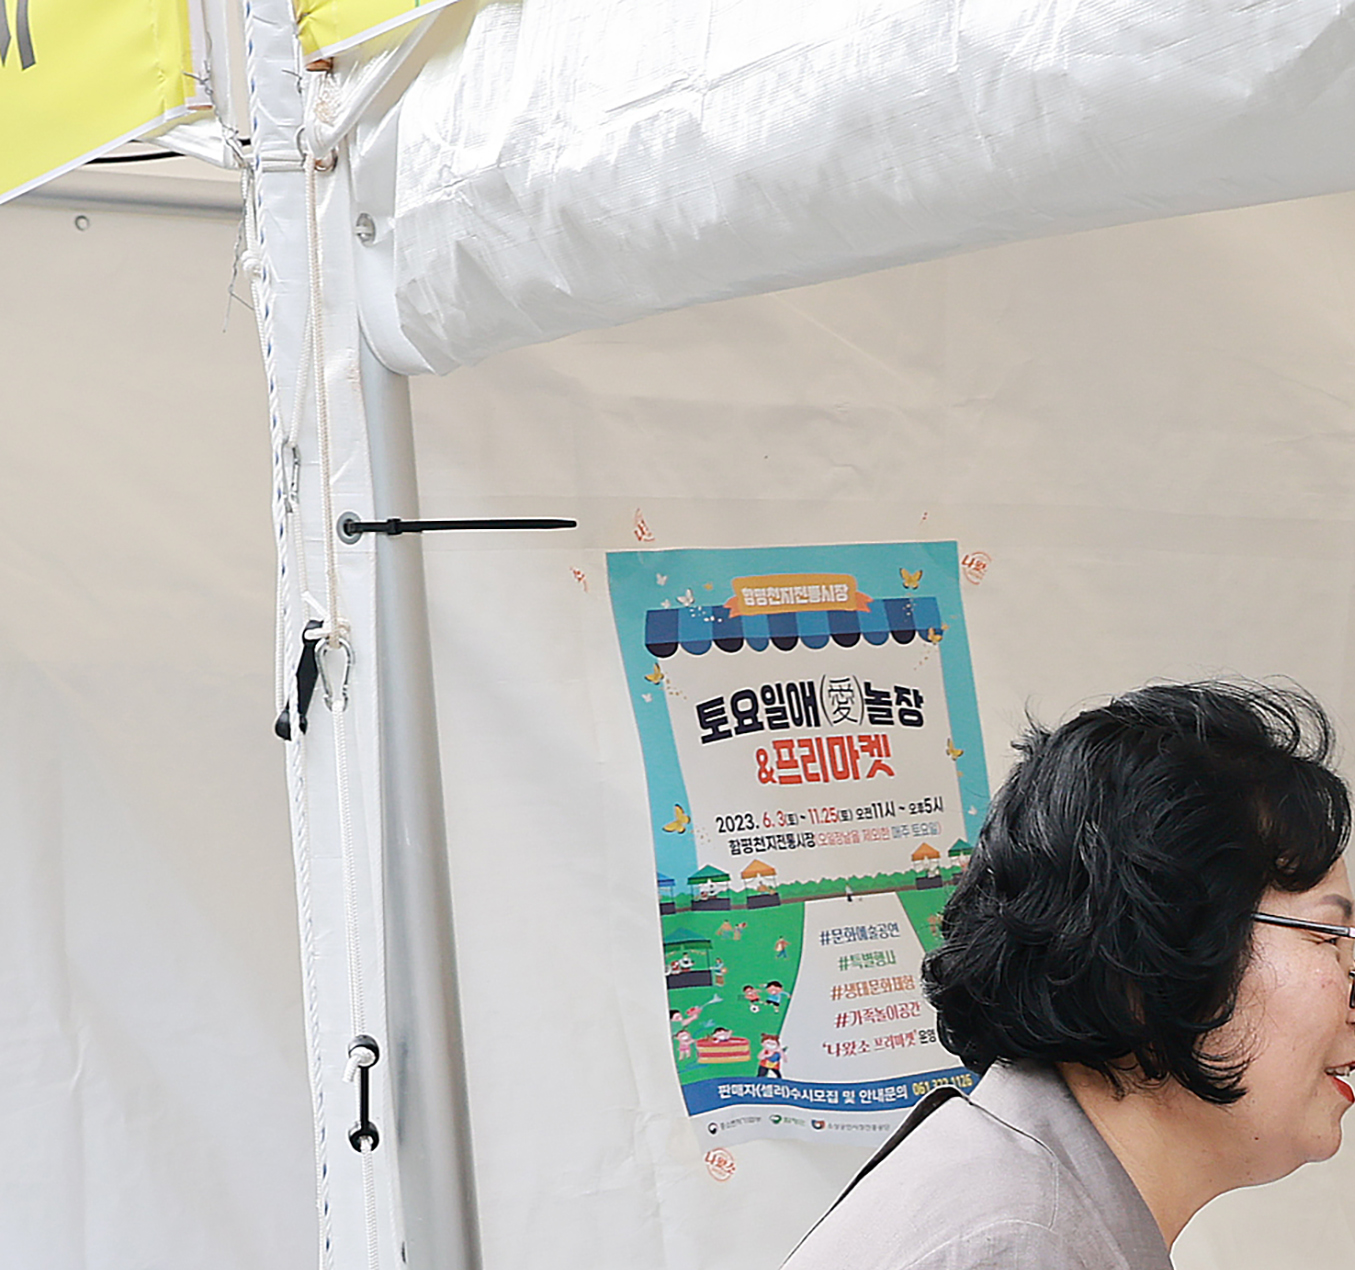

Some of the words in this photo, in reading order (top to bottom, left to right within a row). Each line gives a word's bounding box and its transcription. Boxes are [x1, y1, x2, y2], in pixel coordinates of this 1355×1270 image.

[755, 734, 895, 784] &프리마켓
[716, 813, 760, 833] 2023.
[856, 801, 896, 820] 오전11시
[909, 796, 943, 814] 오후5시
[820, 922, 900, 946] #문화예술공연
[835, 1001, 921, 1028] #가족놀이공간
[842, 1088, 855, 1104] 및
[859, 1085, 908, 1104] 안내문의
